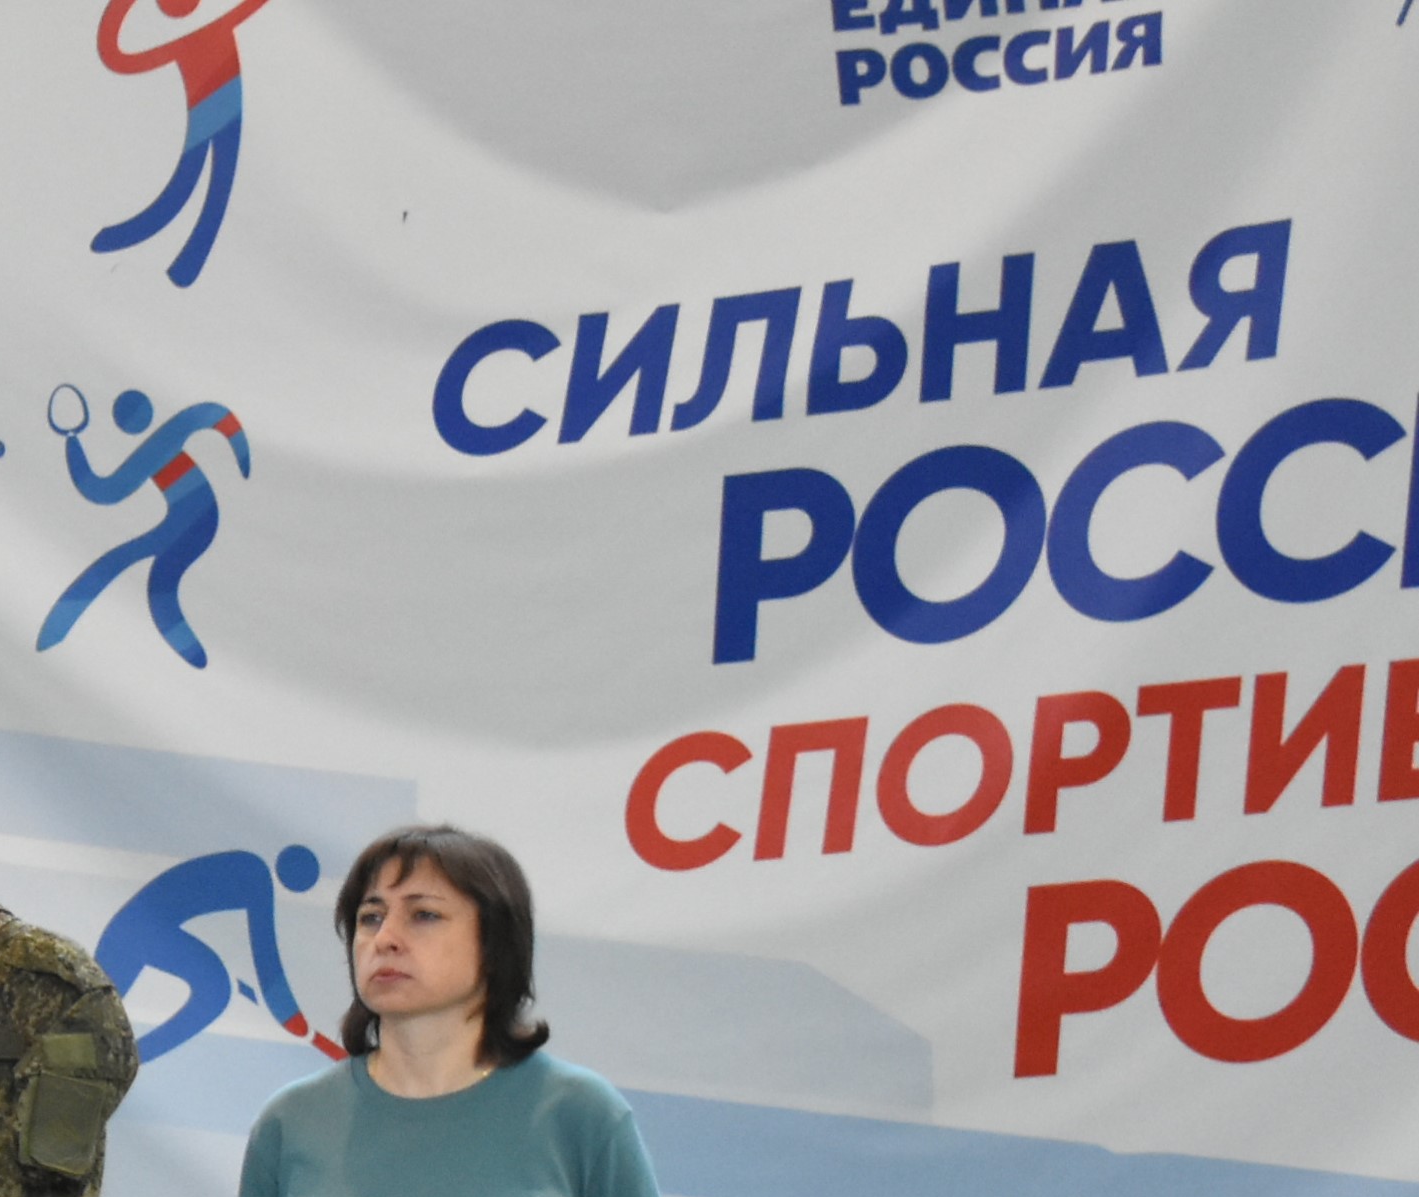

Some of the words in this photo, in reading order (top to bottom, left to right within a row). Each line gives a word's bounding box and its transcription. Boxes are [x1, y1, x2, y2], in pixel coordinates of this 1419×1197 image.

[835, 11, 1164, 106] РОССИЯ
[432, 218, 1292, 458] СИЛЬНАЯ
[712, 394, 1419, 664] РОСС
